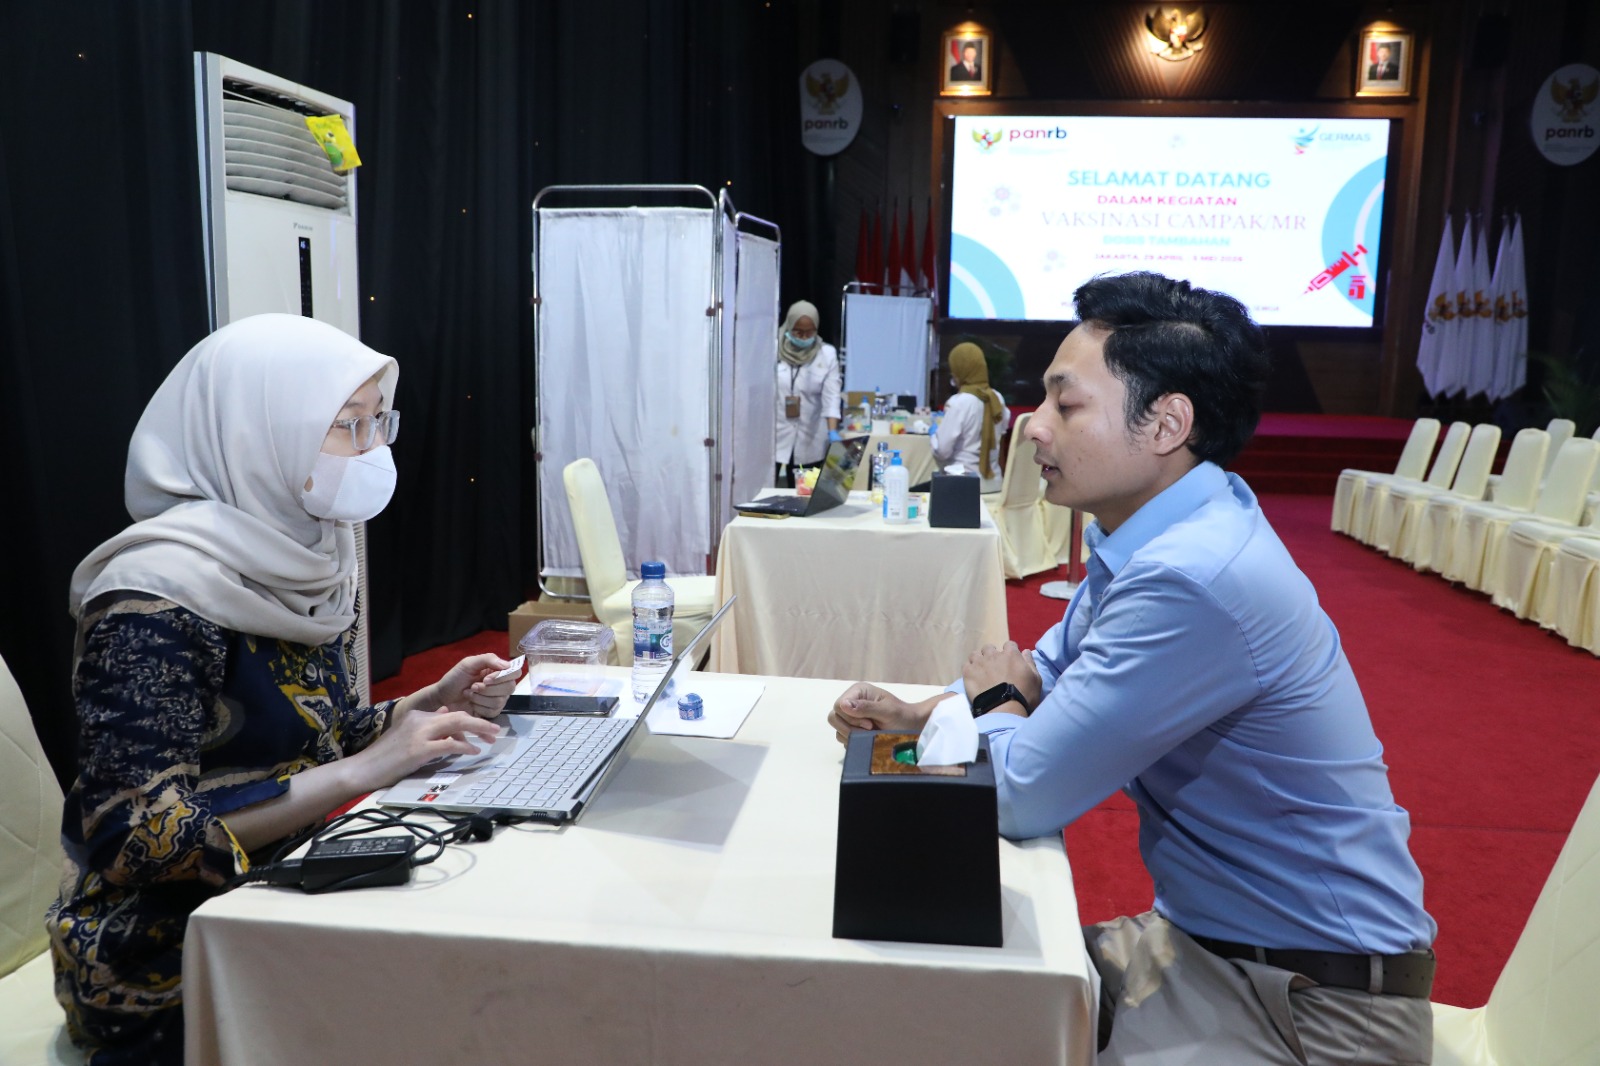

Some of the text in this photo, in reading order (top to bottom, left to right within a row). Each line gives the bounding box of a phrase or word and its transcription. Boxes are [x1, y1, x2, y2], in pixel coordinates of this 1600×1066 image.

[804, 117, 849, 132] panrb
[1009, 126, 1067, 142] panrb
[1319, 132, 1371, 142] GERMAS
[1545, 124, 1595, 141] panrb
[1068, 170, 1271, 188] SELAMAT DATANG
[1097, 195, 1237, 206] DALAM KEGIATAN
[1042, 211, 1307, 231] VAKSINASI CAMPAK/MR
[1148, 235, 1231, 246] TAMBAHAN
